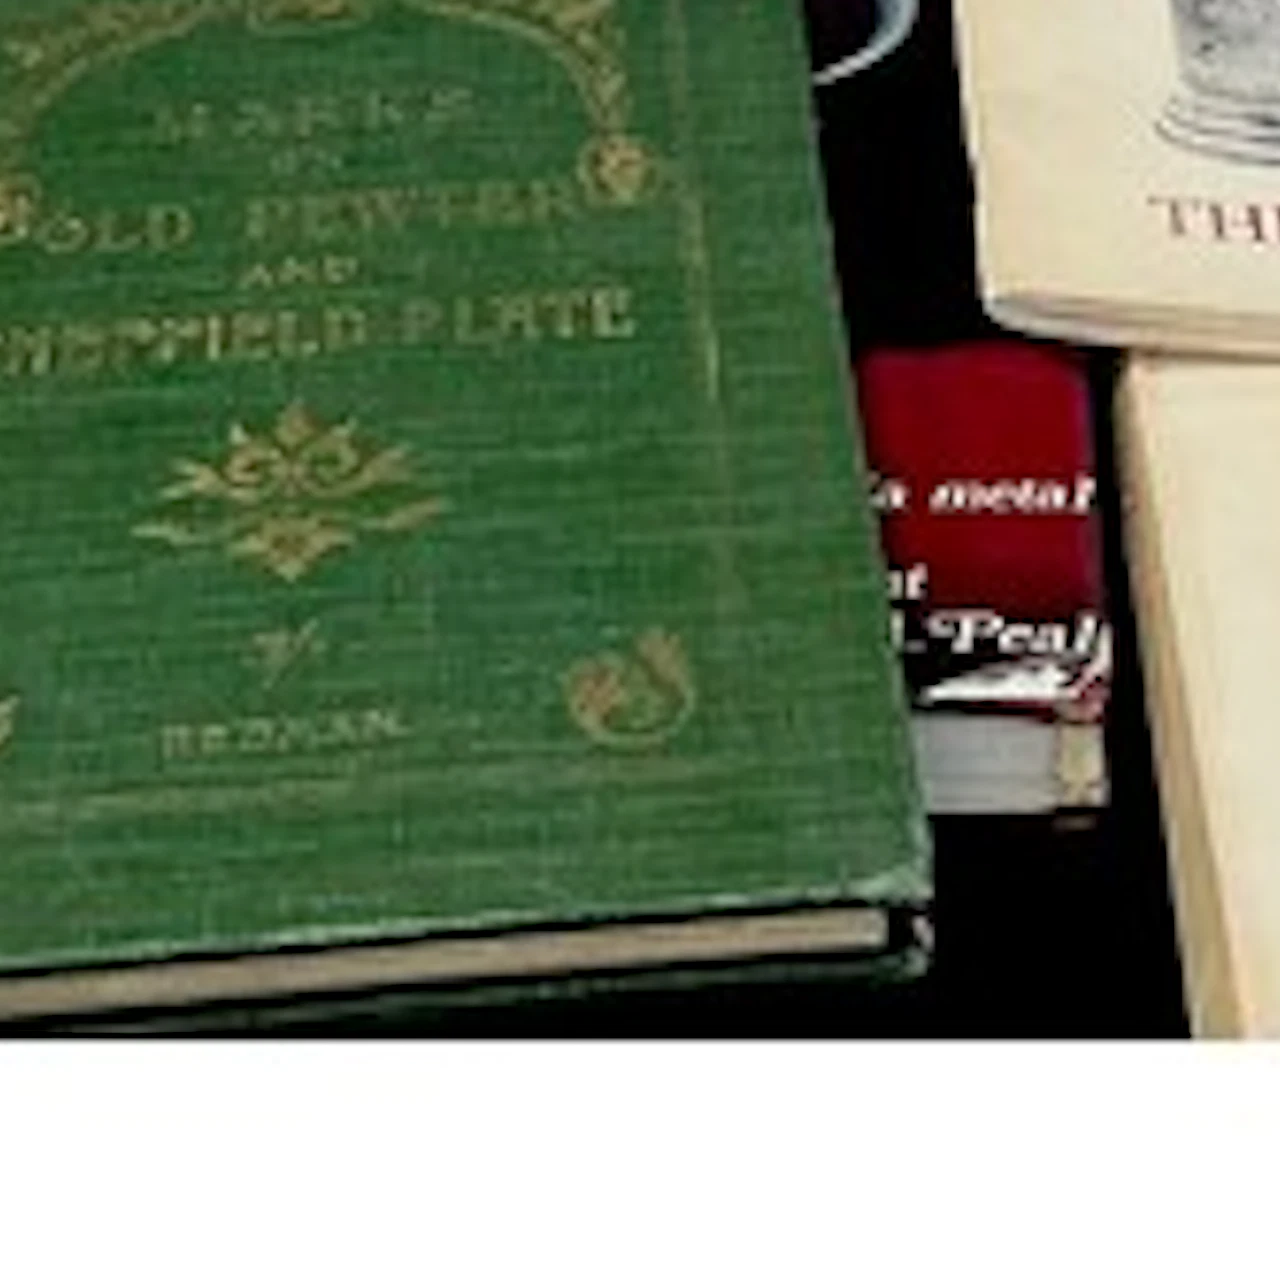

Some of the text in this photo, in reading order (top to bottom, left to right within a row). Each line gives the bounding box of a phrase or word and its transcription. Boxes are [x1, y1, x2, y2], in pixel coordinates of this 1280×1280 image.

[152, 85, 478, 143] MARKS
[35, 176, 579, 255] OLD PEWTER
[238, 254, 361, 289] AND
[401, 286, 638, 348] PLATE
[928, 473, 1098, 515] metal
